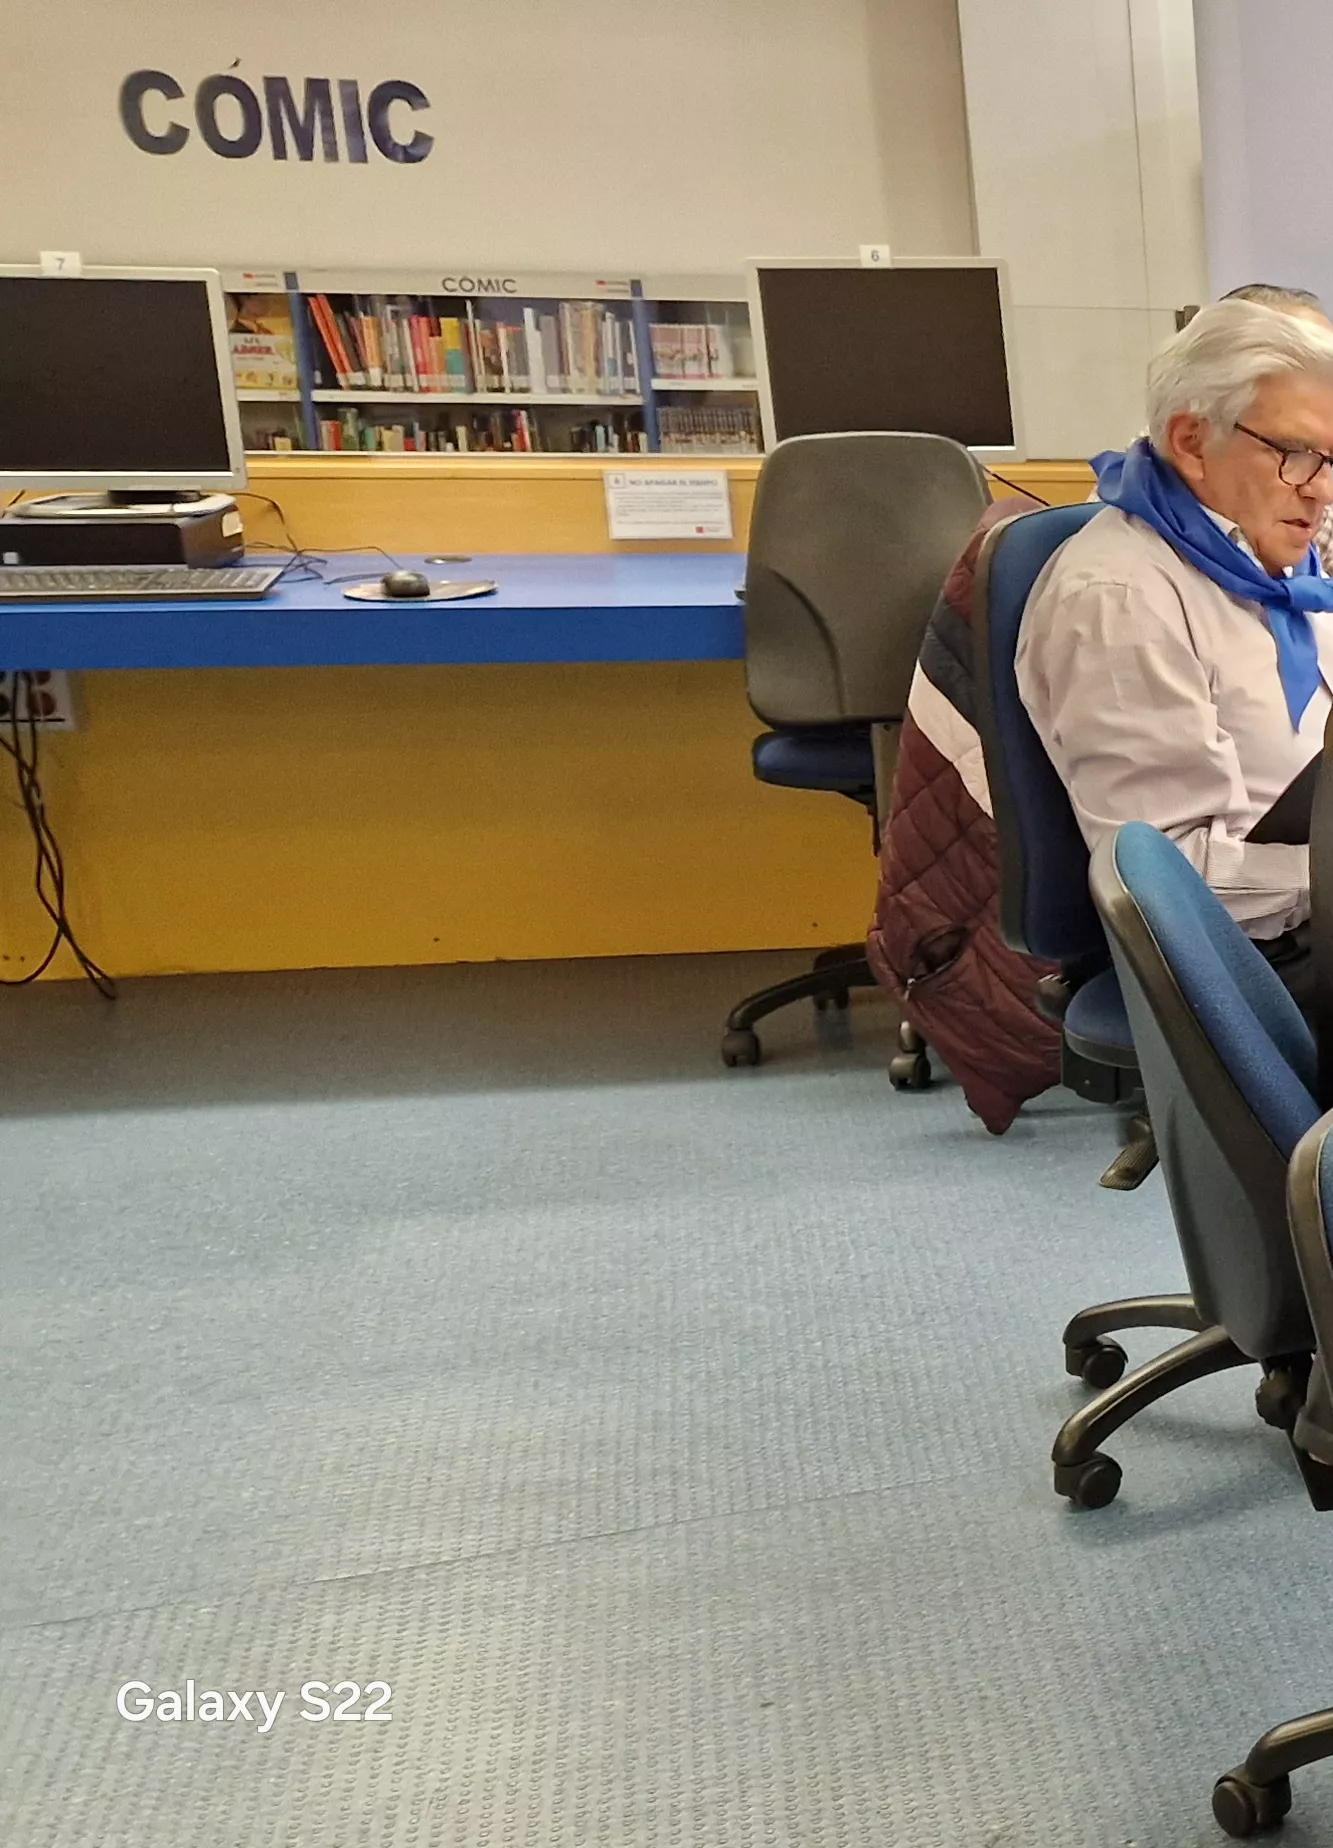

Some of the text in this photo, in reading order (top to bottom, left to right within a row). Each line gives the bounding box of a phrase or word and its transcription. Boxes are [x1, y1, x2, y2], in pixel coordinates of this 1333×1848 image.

[118, 57, 435, 164] CÓMIC
[870, 249, 880, 262] 6
[55, 257, 66, 271] 7
